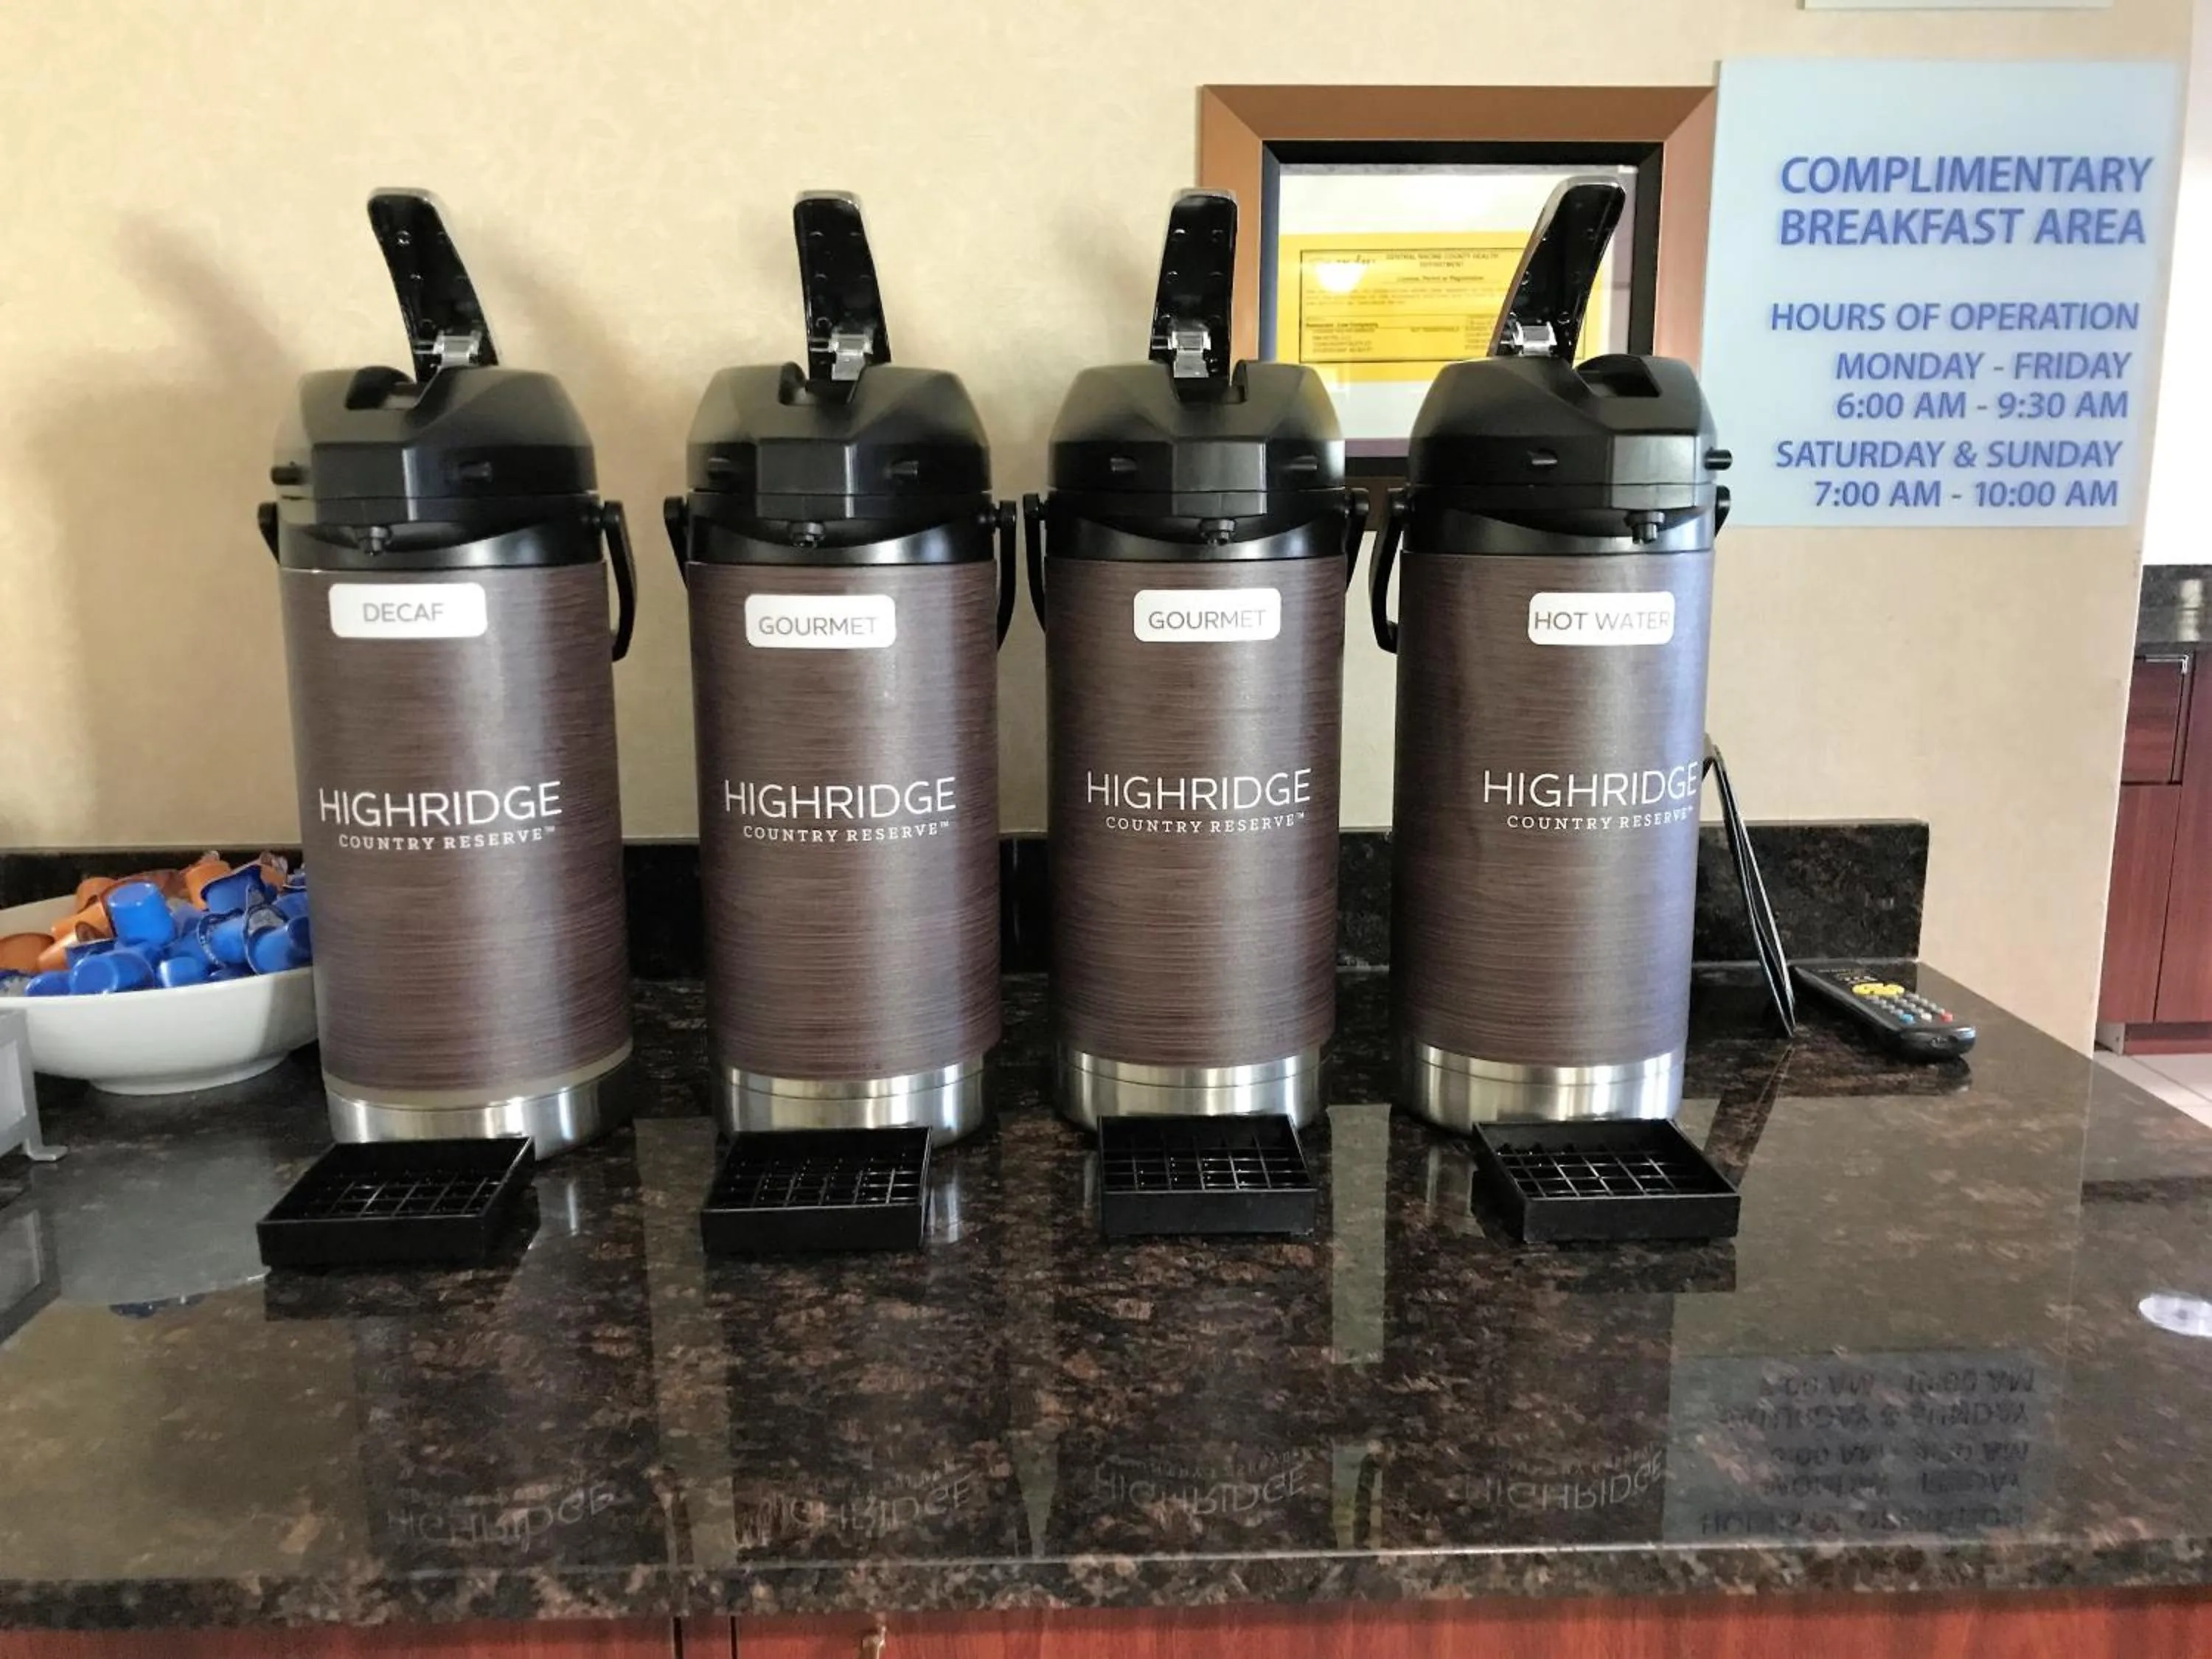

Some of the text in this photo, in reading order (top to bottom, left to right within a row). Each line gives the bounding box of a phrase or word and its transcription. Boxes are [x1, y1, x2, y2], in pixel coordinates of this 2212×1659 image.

[1781, 156, 2154, 195] COMPLIMENTARY
[1781, 207, 2146, 246] BREAKFAST AREA
[1771, 302, 2140, 331] HOURS OF OPERATION
[1835, 352, 1985, 380] MONDAY
[2014, 351, 2133, 380] FRIDAY
[1836, 392, 1905, 420] 6:00
[1913, 391, 1966, 420] AM
[1997, 391, 2066, 420] 9:30
[2073, 390, 2129, 419] AM
[1775, 439, 2124, 469] SATURDAY & SUNDAY
[1815, 481, 1880, 508] 7:00
[1888, 480, 1941, 508] AM
[1975, 480, 2056, 508] 10:00
[2064, 479, 2118, 507] AM
[363, 602, 445, 623] DECAF
[759, 616, 879, 636] GOURMET
[1148, 609, 1267, 630] GOURMET
[1534, 611, 1671, 630] HOT WATER
[725, 776, 956, 819] HIGHRIDGE
[1088, 768, 1312, 810] HIGHRIDGE
[1484, 761, 1698, 807] HIGHRIDGE
[319, 780, 563, 827] HIGHRIDGE
[743, 825, 839, 843] COUNTRY
[1106, 816, 1203, 832] COUNTRY
[1507, 815, 1613, 830] COUNTRY
[338, 834, 435, 850] COUNTRY
